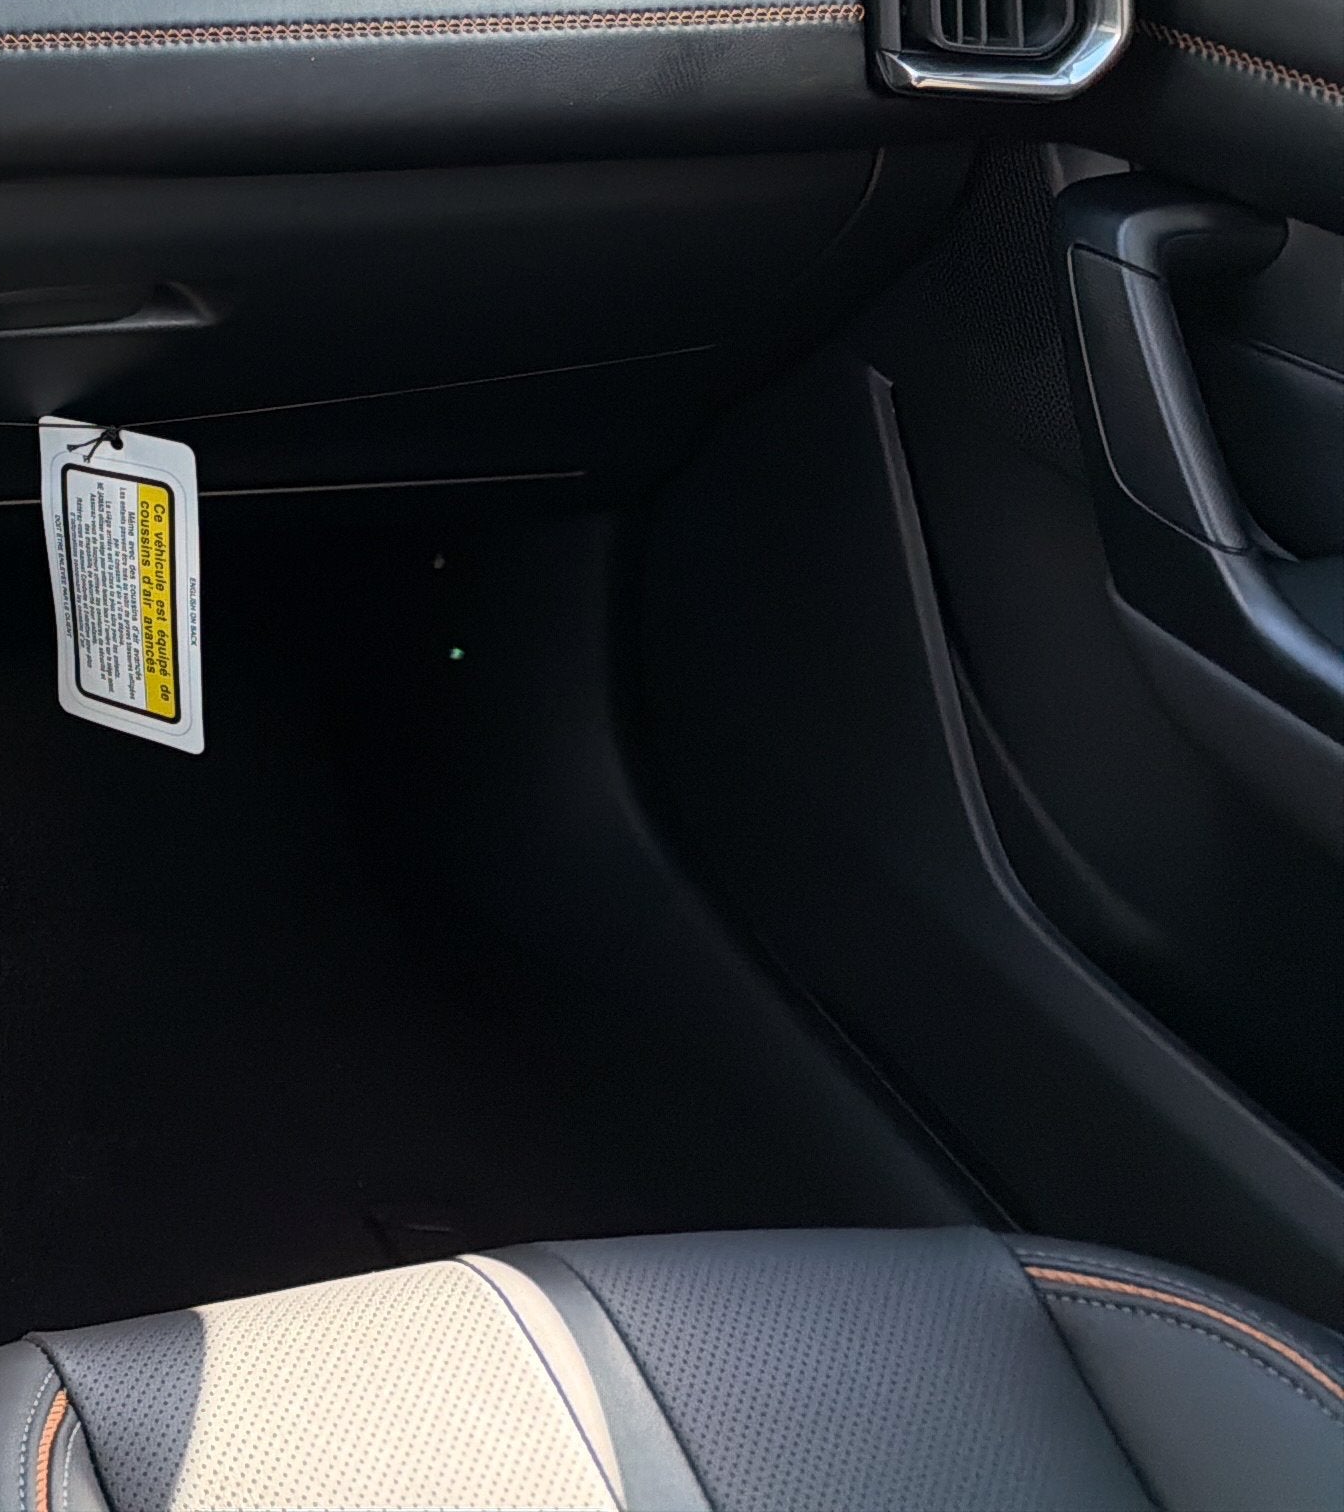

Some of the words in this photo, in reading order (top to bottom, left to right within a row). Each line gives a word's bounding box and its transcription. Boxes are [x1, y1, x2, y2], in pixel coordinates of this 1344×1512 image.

[153, 502, 165, 524] Ce
[138, 500, 152, 567] coussins
[152, 530, 167, 592] véhicule
[141, 575, 154, 608] d'air
[188, 576, 196, 611] ENGLISH
[155, 599, 166, 622] est
[143, 616, 157, 674] avancés
[189, 624, 197, 646] BACK
[154, 628, 169, 677] équipé
[159, 683, 170, 702] de
